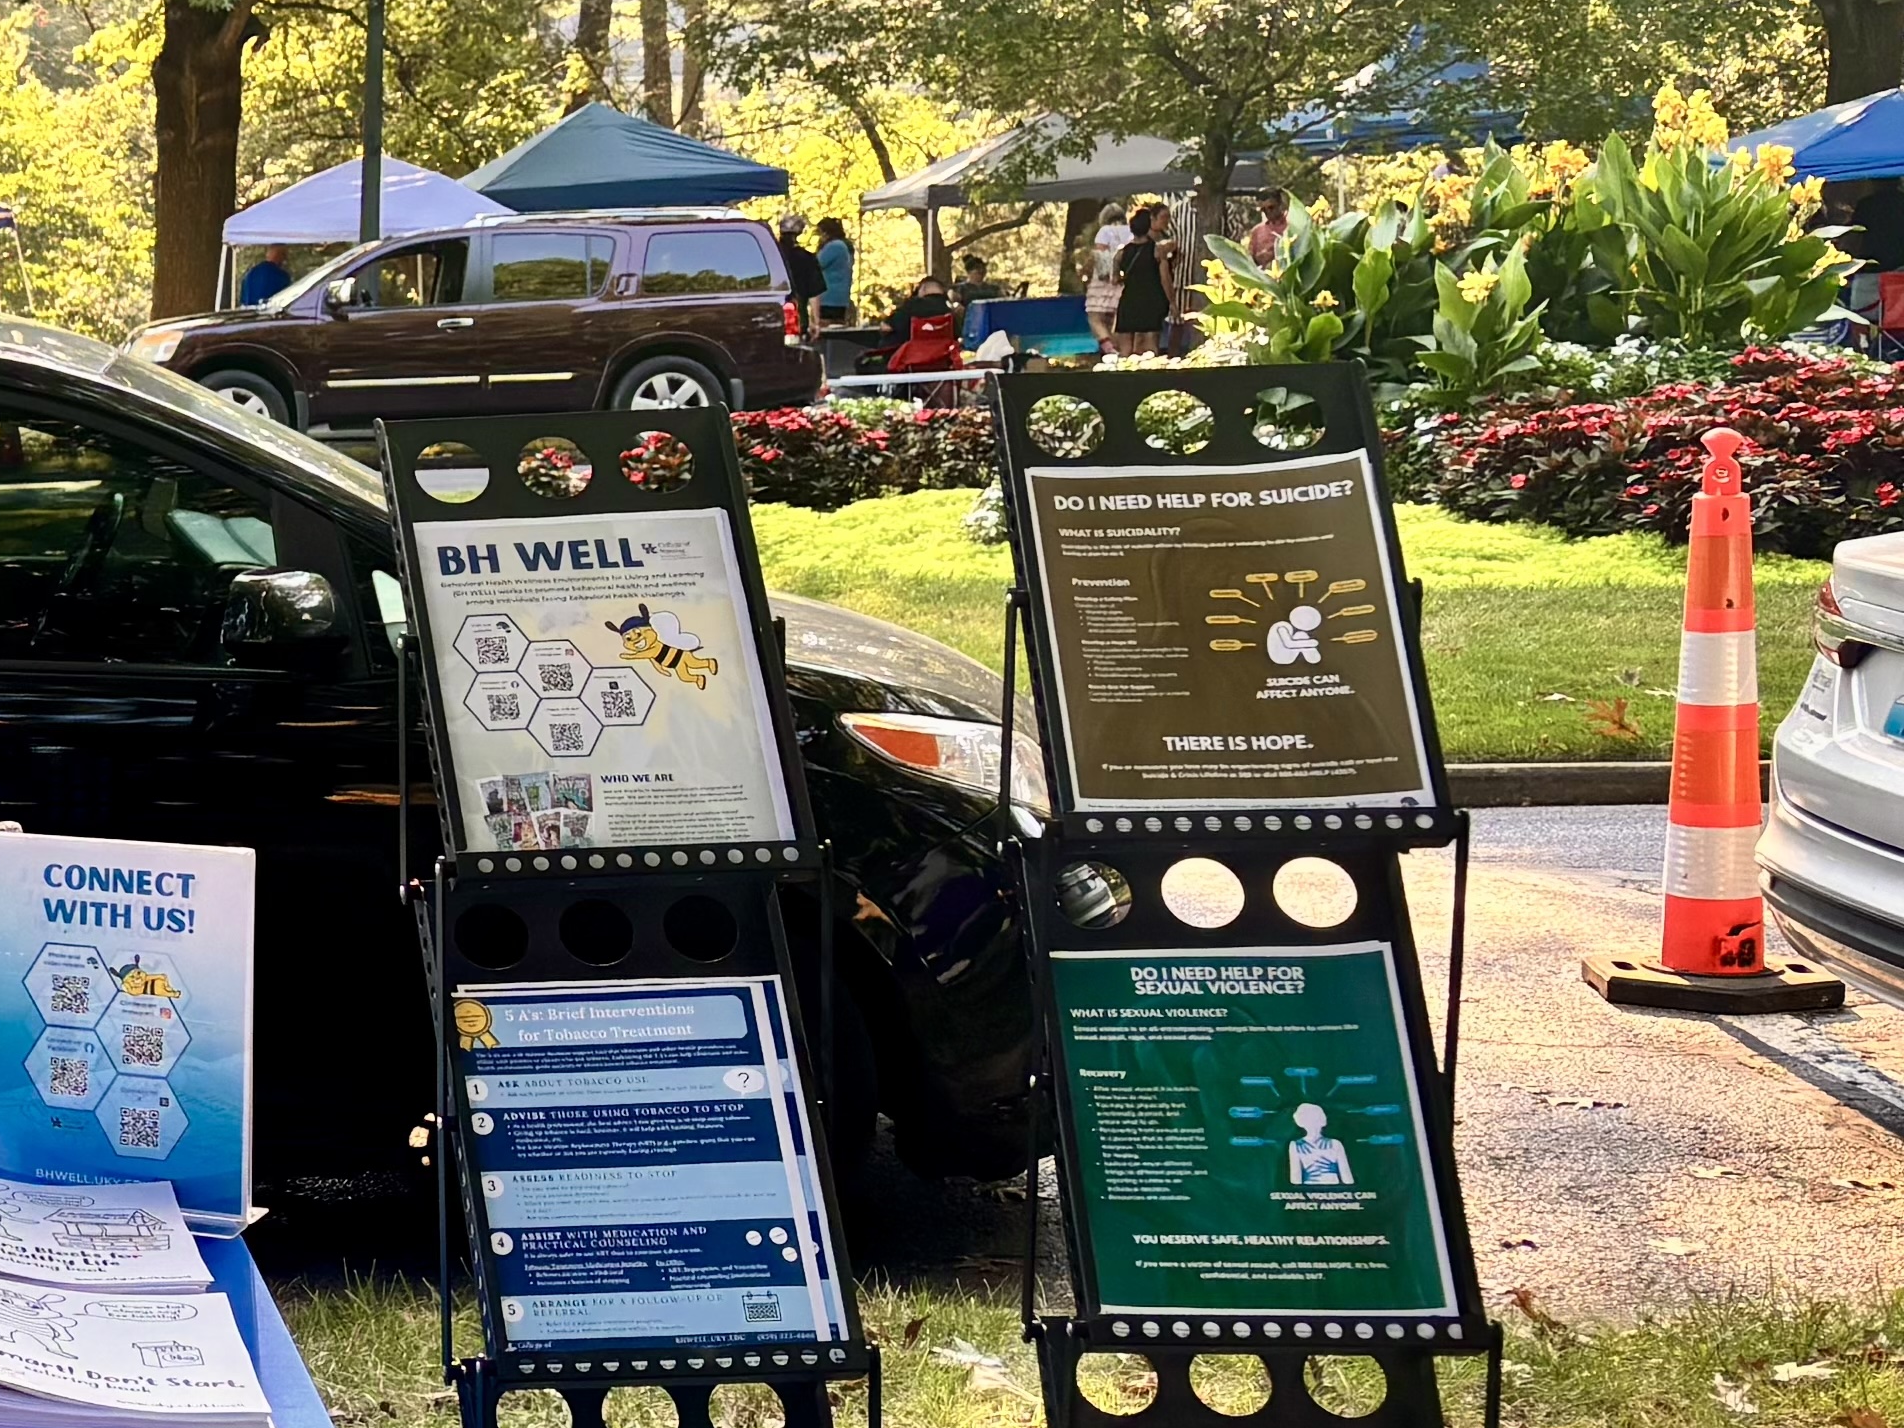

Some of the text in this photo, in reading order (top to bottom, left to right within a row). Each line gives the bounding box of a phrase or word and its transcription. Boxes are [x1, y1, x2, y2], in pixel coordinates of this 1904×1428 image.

[1054, 480, 1354, 511] DO I NEED HELP FOR SUICIDE?
[437, 538, 643, 576] BH WELL
[601, 773, 674, 784] WHO WE ARE
[43, 864, 196, 898] CONNECT
[42, 898, 196, 934] WITH US!
[505, 1010, 514, 1021] 5
[548, 1007, 585, 1021] Brief
[590, 1003, 694, 1019] Interventions
[519, 1024, 693, 1042] for Tobacco Treatment
